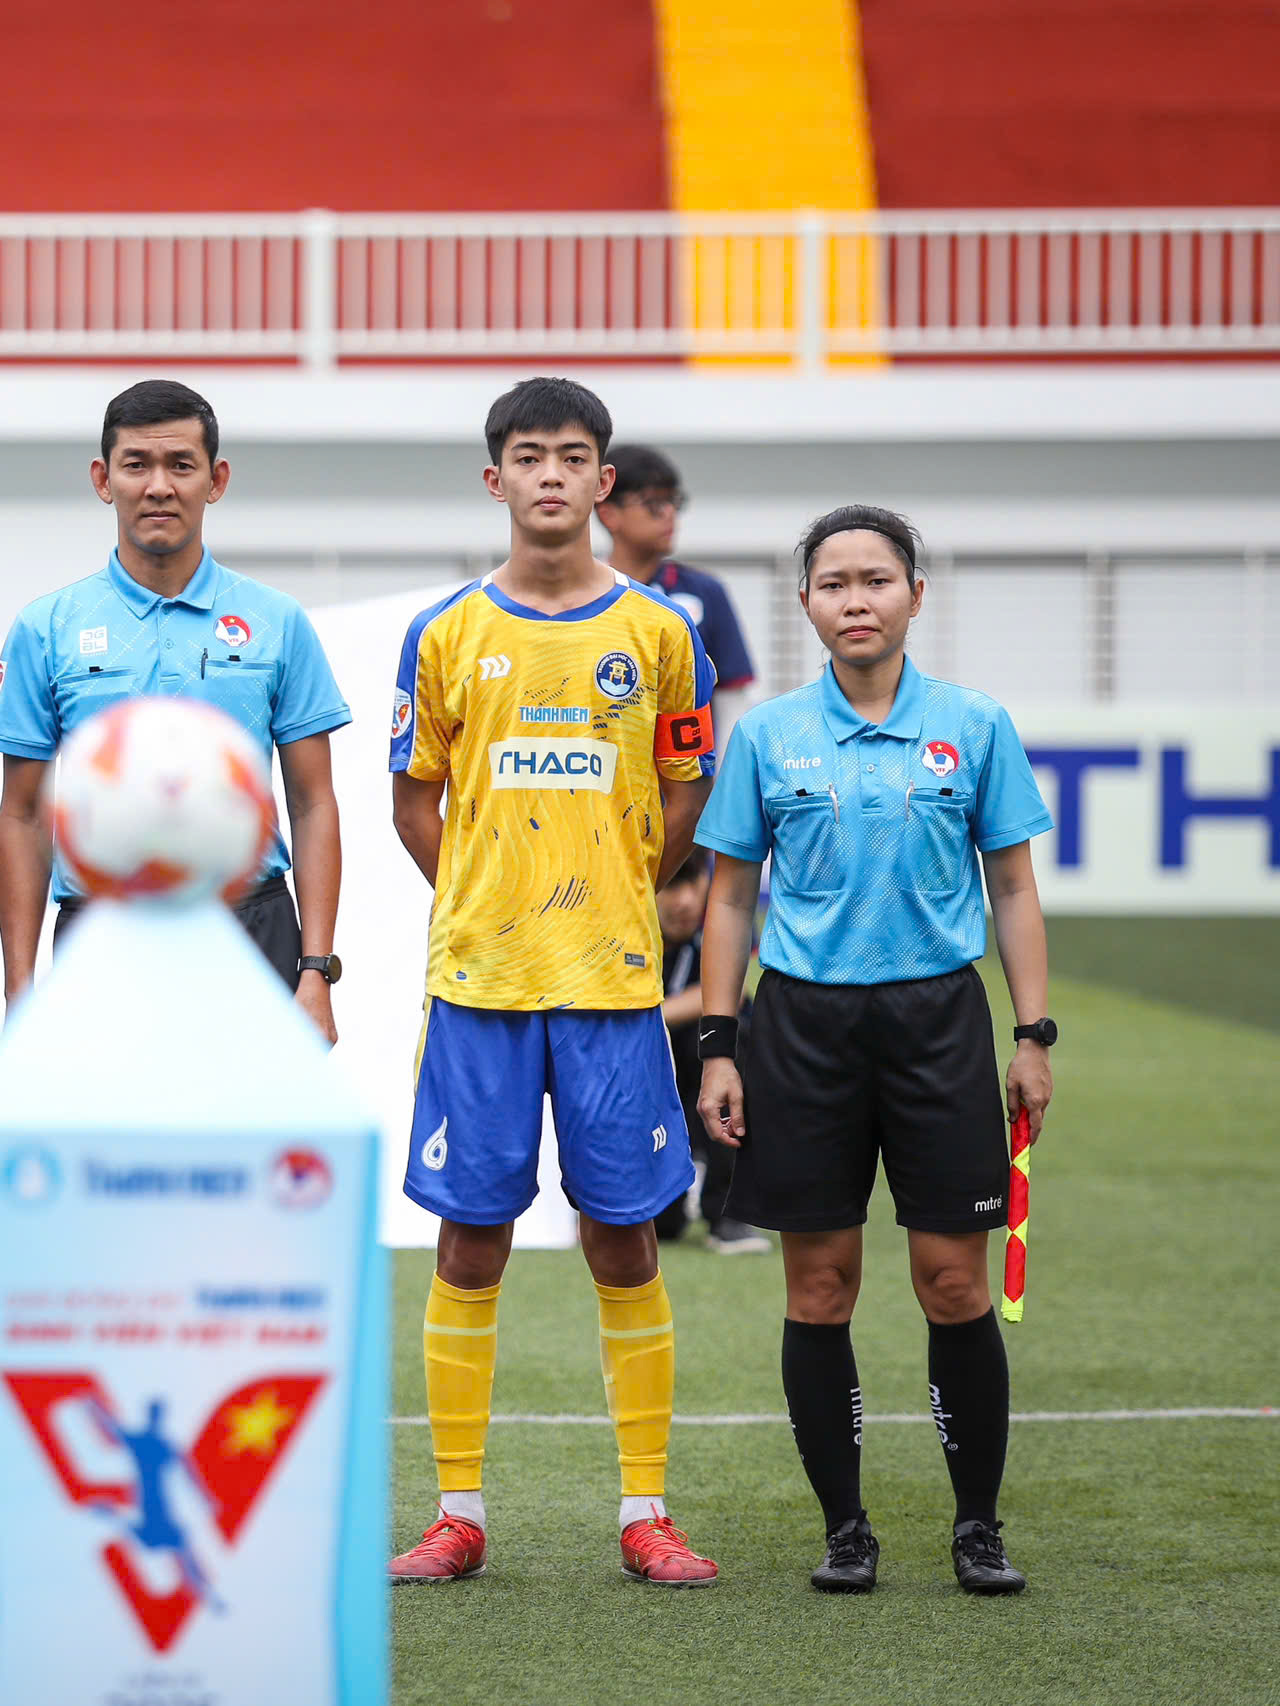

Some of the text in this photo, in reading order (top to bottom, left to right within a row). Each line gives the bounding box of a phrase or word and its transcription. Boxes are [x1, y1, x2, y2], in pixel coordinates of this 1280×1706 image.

[519, 705, 560, 722] THANH
[670, 715, 703, 752] C
[498, 751, 603, 777] THACO
[784, 756, 822, 770] mitre
[422, 1115, 447, 1170] 6
[974, 1197, 1002, 1212] mitre
